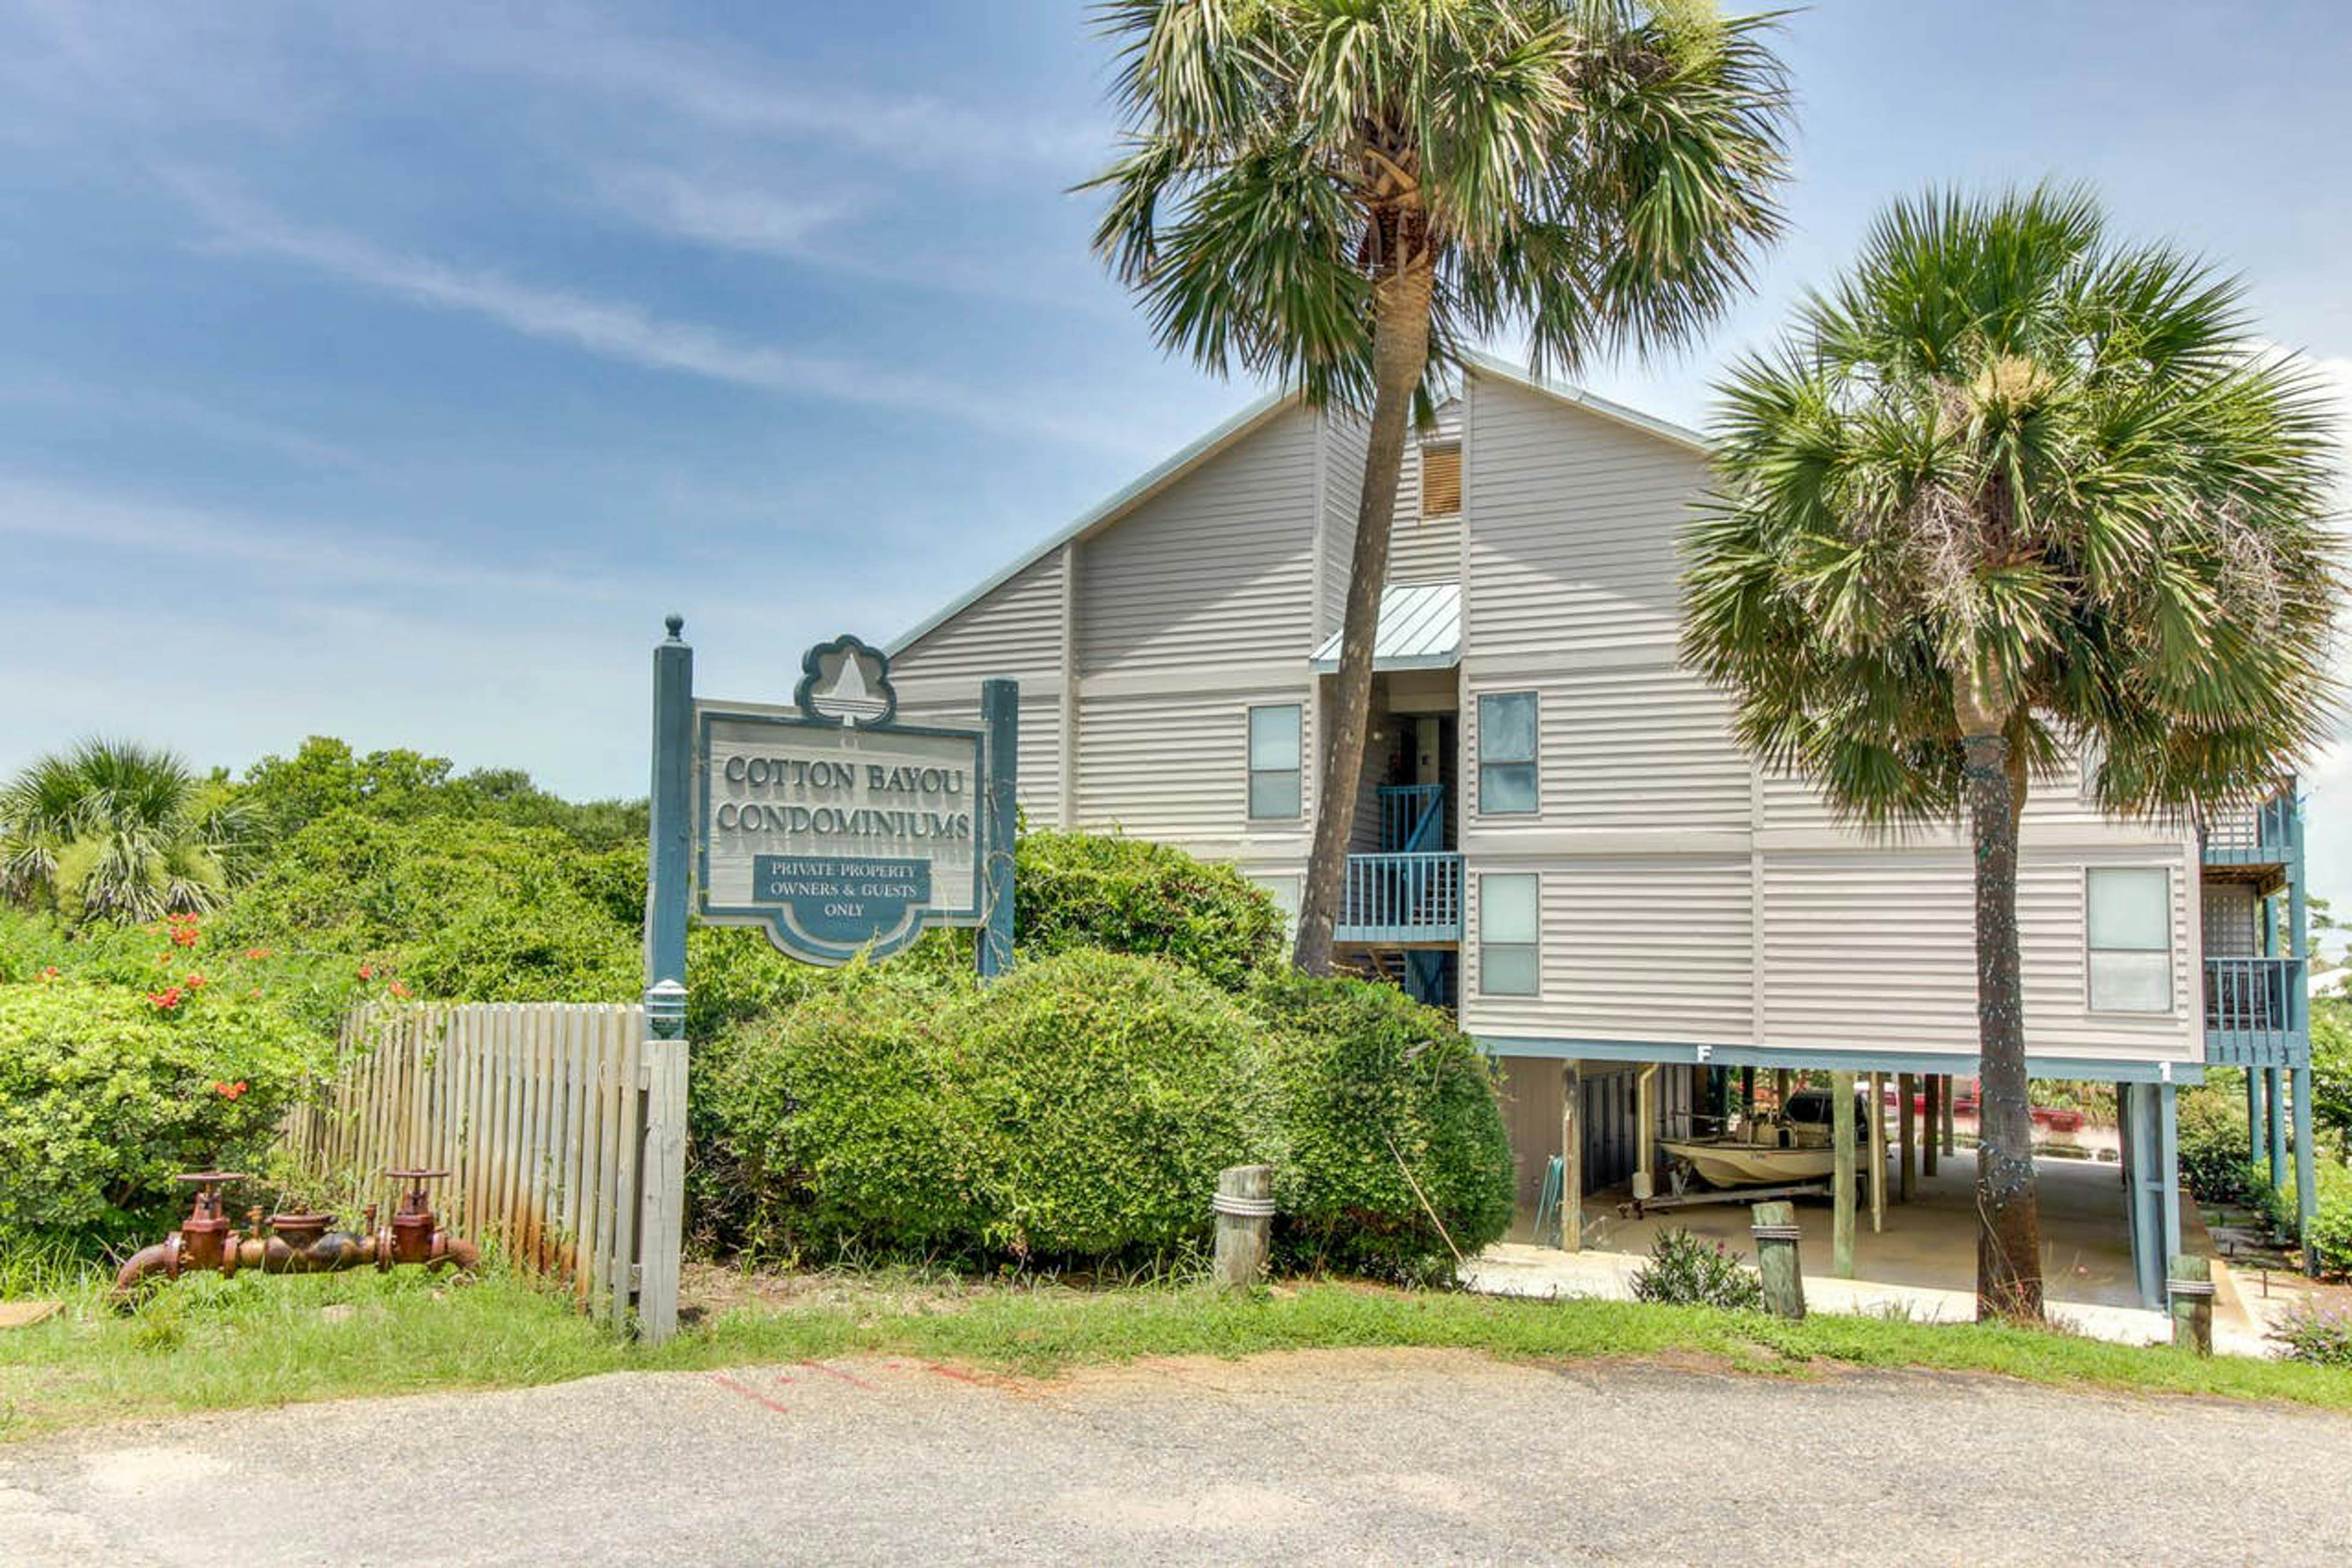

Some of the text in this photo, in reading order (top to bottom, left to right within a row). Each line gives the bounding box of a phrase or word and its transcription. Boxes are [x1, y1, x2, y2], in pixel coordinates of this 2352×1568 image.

[725, 756, 963, 794] COTTON BAYOU
[717, 803, 970, 839] CONDOMINIUMS
[771, 861, 915, 878] PRIVATE PROPERTY
[771, 882, 917, 897] OWNERS & GUESTS
[824, 903, 865, 917] ONLY
